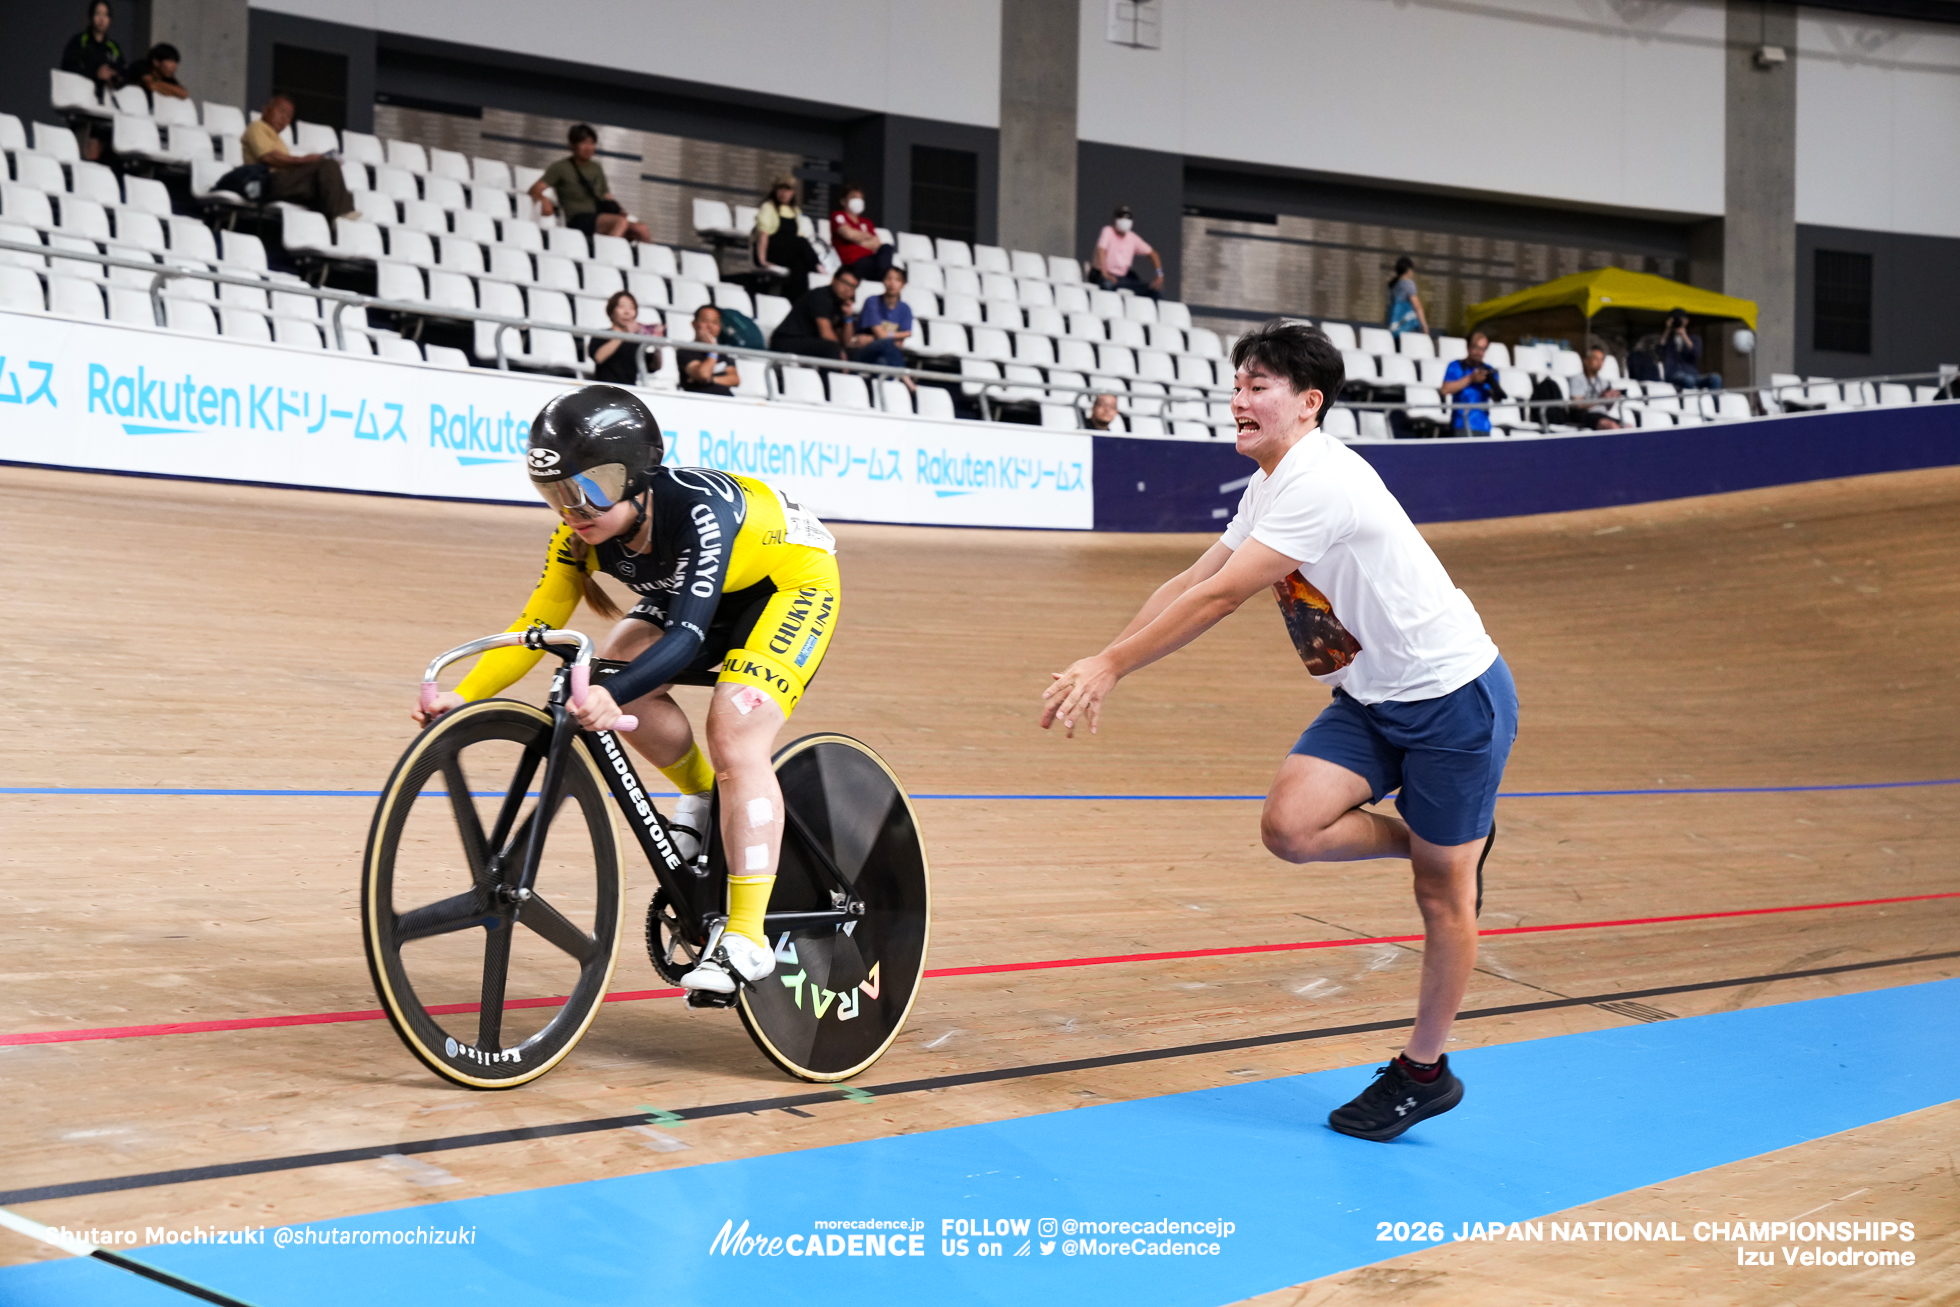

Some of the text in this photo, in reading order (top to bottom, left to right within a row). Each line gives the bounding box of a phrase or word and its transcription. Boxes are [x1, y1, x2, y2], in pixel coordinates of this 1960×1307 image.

[430, 403, 531, 456] Rakute
[690, 503, 722, 599] CHUKYO
[768, 587, 818, 654] CHUKYO
[809, 589, 835, 637] UNIV
[722, 658, 790, 694] HUKYO
[596, 729, 682, 871] RIDGESTONE
